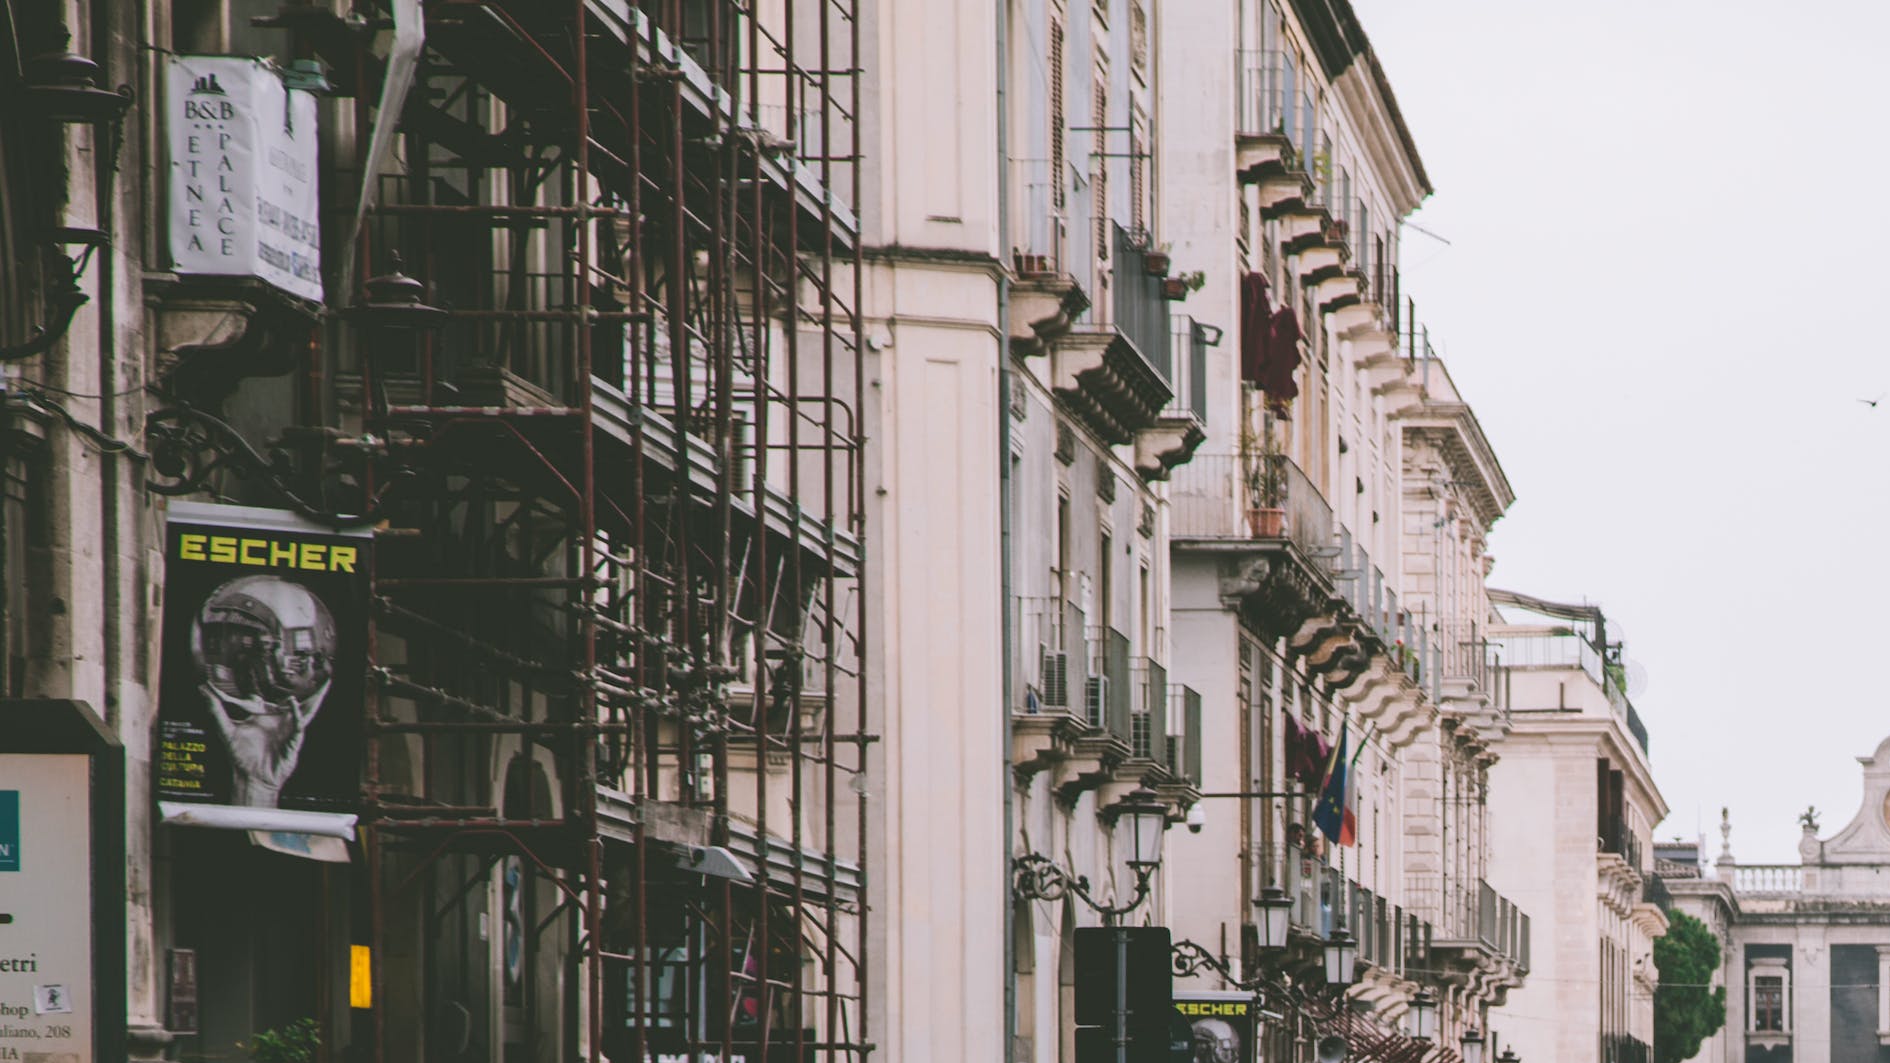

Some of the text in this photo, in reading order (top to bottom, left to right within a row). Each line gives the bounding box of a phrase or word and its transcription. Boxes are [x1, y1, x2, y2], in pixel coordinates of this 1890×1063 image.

[184, 100, 234, 120] B&B
[186, 136, 204, 252] ETNEA
[217, 133, 234, 256] PALACE
[180, 533, 357, 573] ESCHER
[45, 1024, 71, 1039] 208
